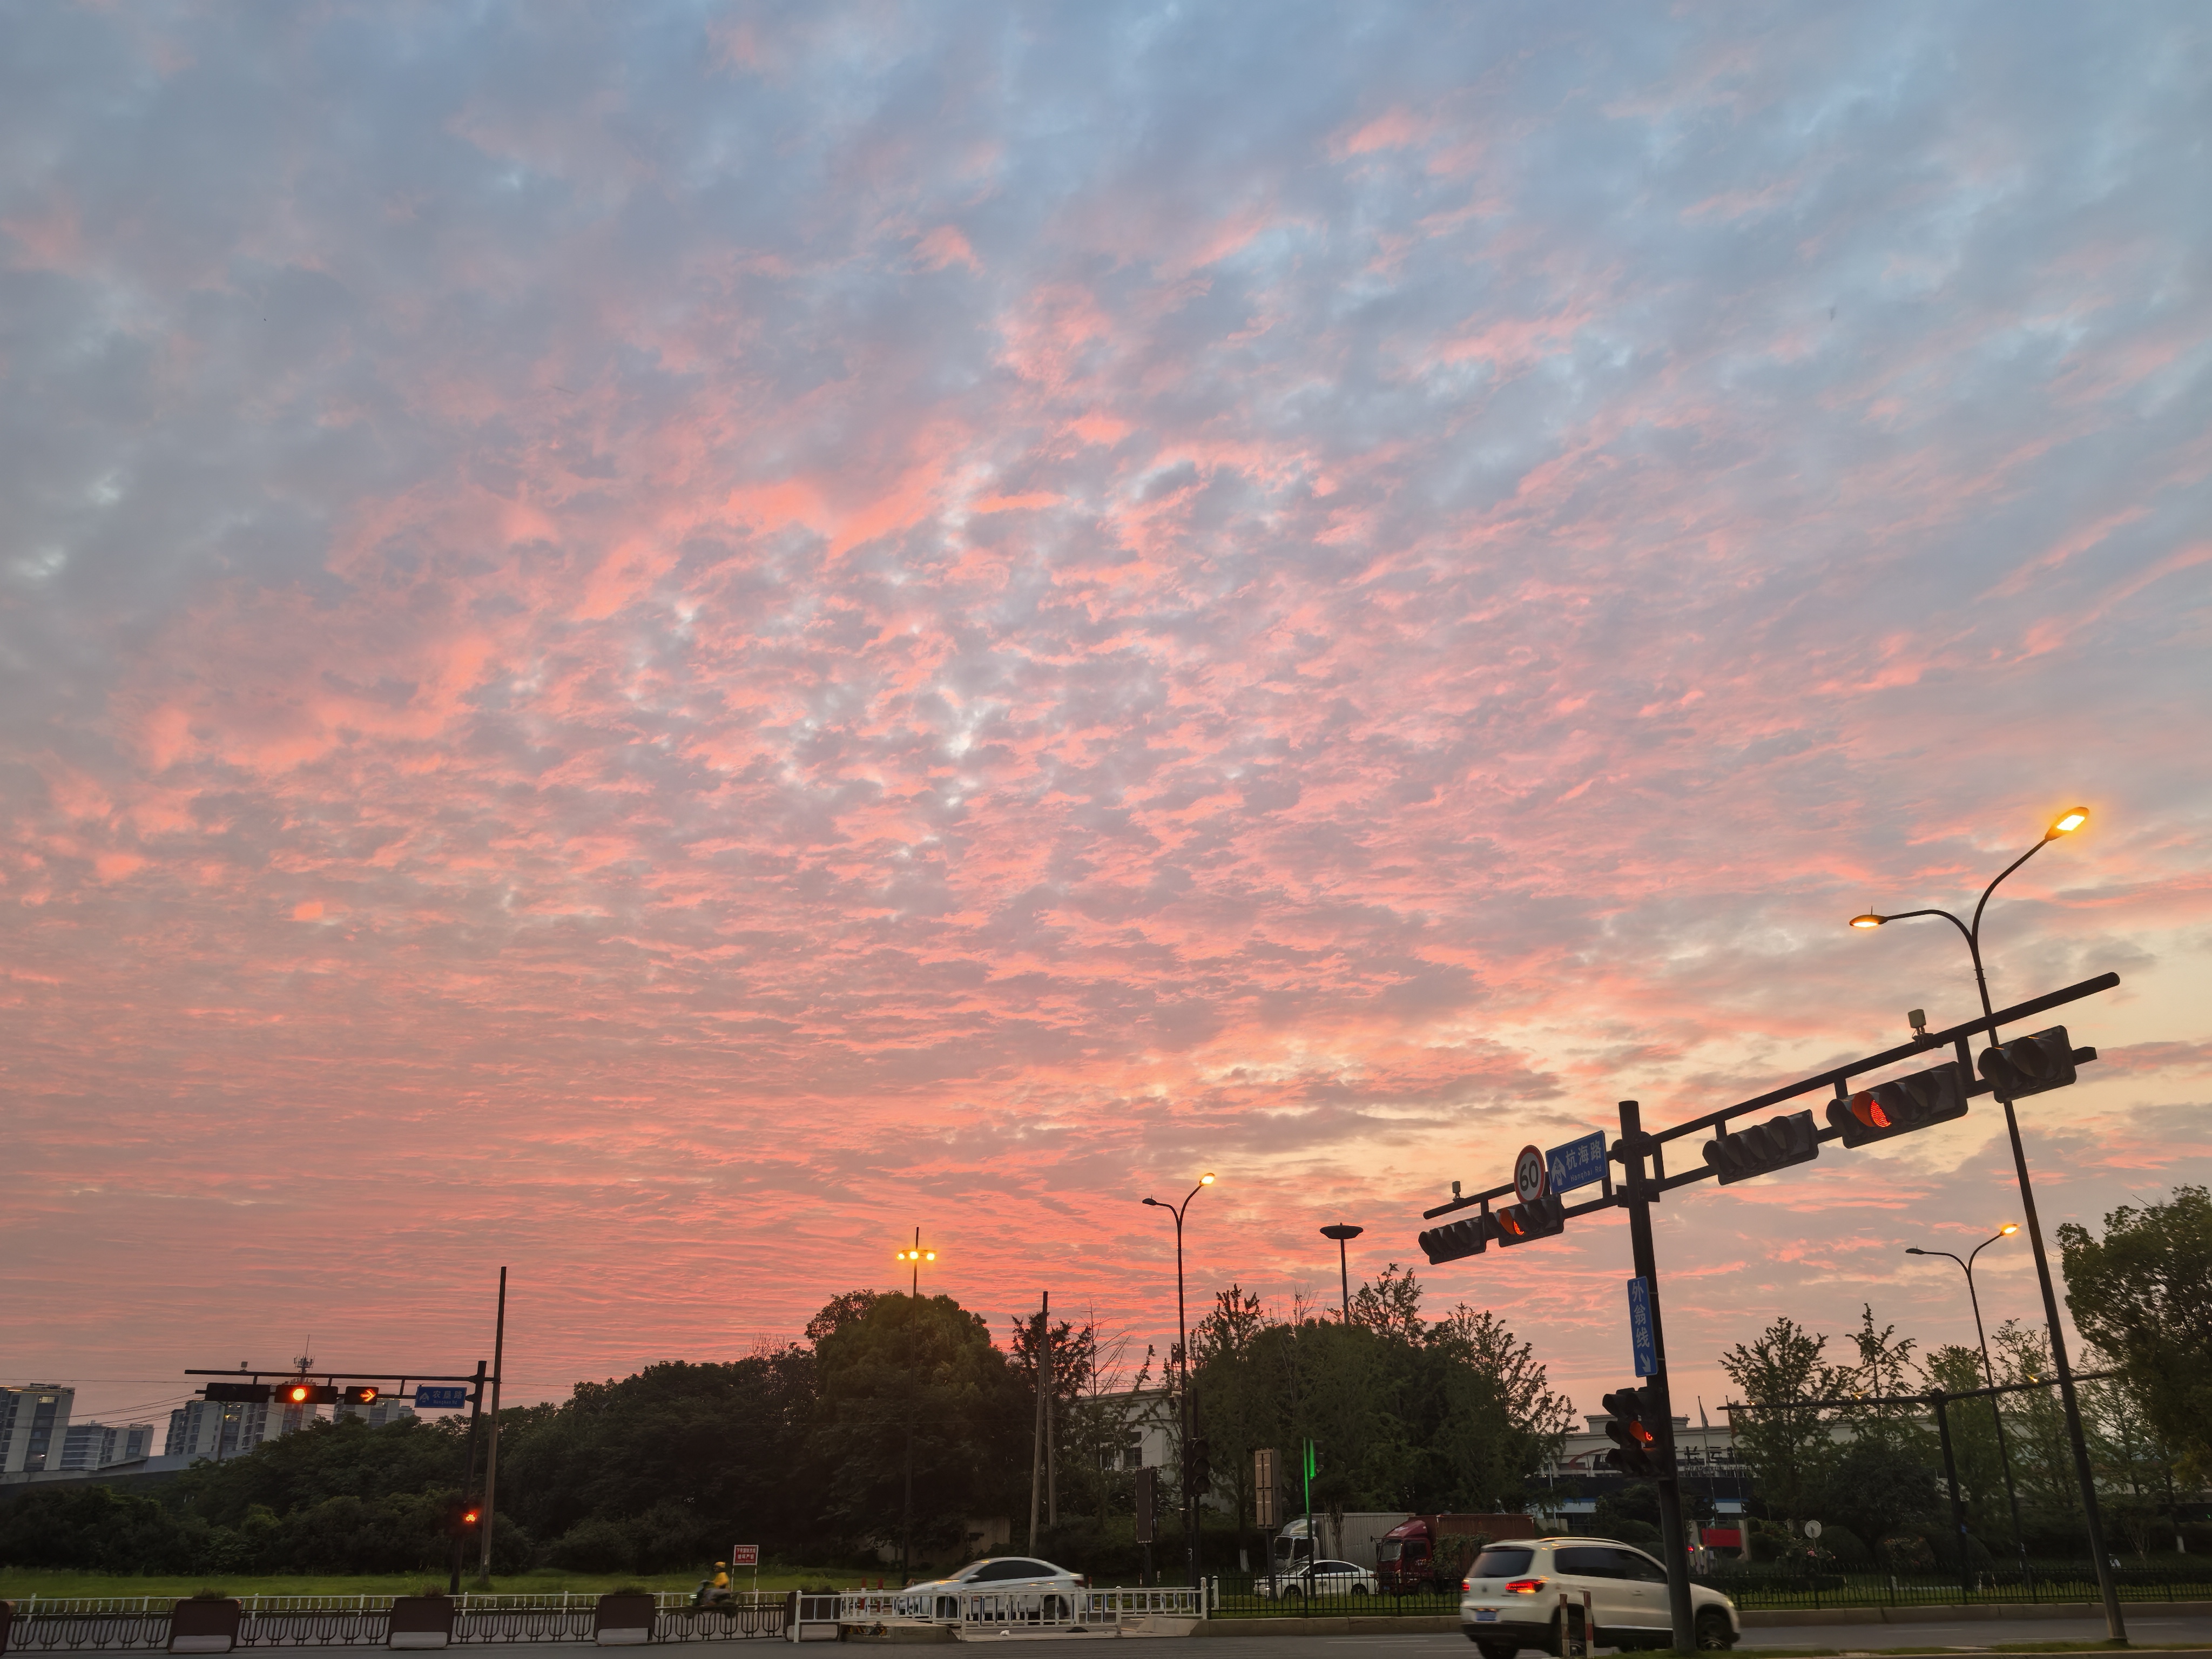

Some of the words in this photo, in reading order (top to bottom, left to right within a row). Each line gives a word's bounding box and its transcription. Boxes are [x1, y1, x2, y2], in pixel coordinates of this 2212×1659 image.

[1566, 1139, 1601, 1170] 杭海路
[1519, 1160, 1539, 1192] 60
[1570, 1168, 1593, 1182] Hanghai
[1595, 1165, 1602, 1174] Rd
[1631, 1280, 1650, 1349] 外翁线
